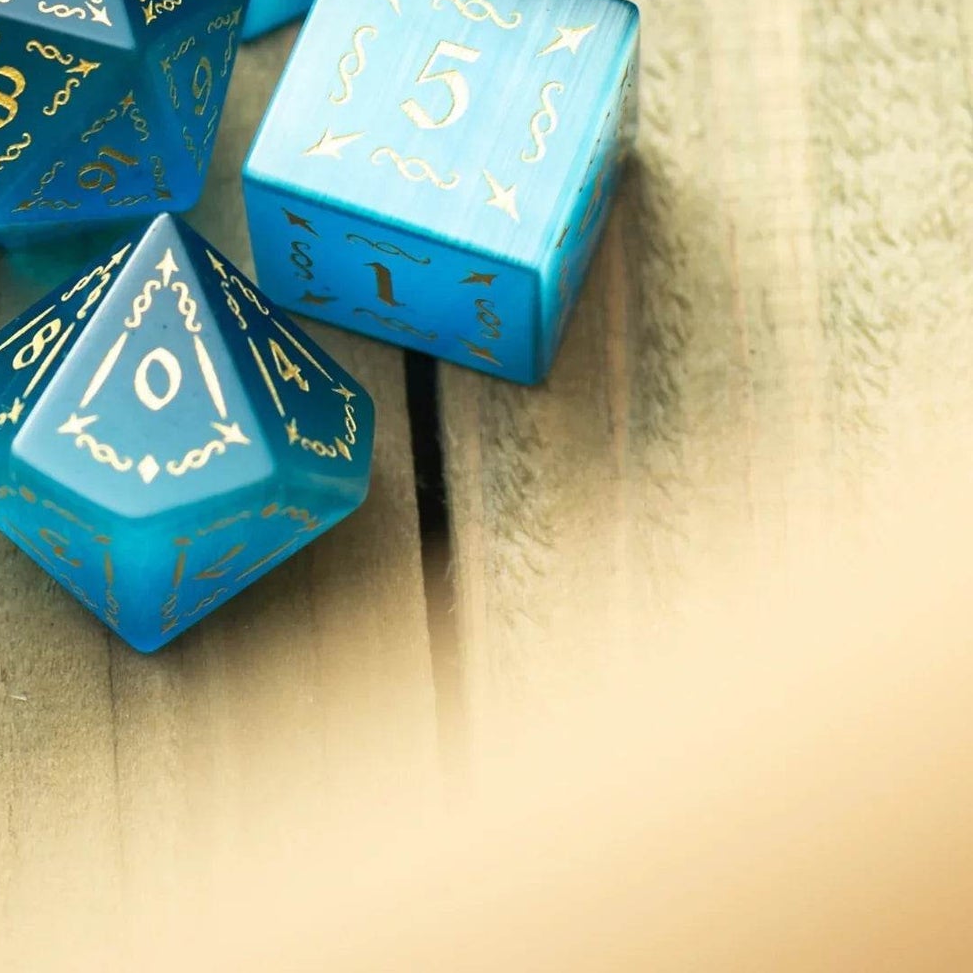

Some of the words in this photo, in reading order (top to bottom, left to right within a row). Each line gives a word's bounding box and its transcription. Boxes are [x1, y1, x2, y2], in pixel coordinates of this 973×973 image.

[399, 39, 483, 130] 5
[362, 261, 408, 309] 1
[11, 317, 63, 372] 8
[267, 336, 311, 394] 4
[133, 346, 183, 412] 0
